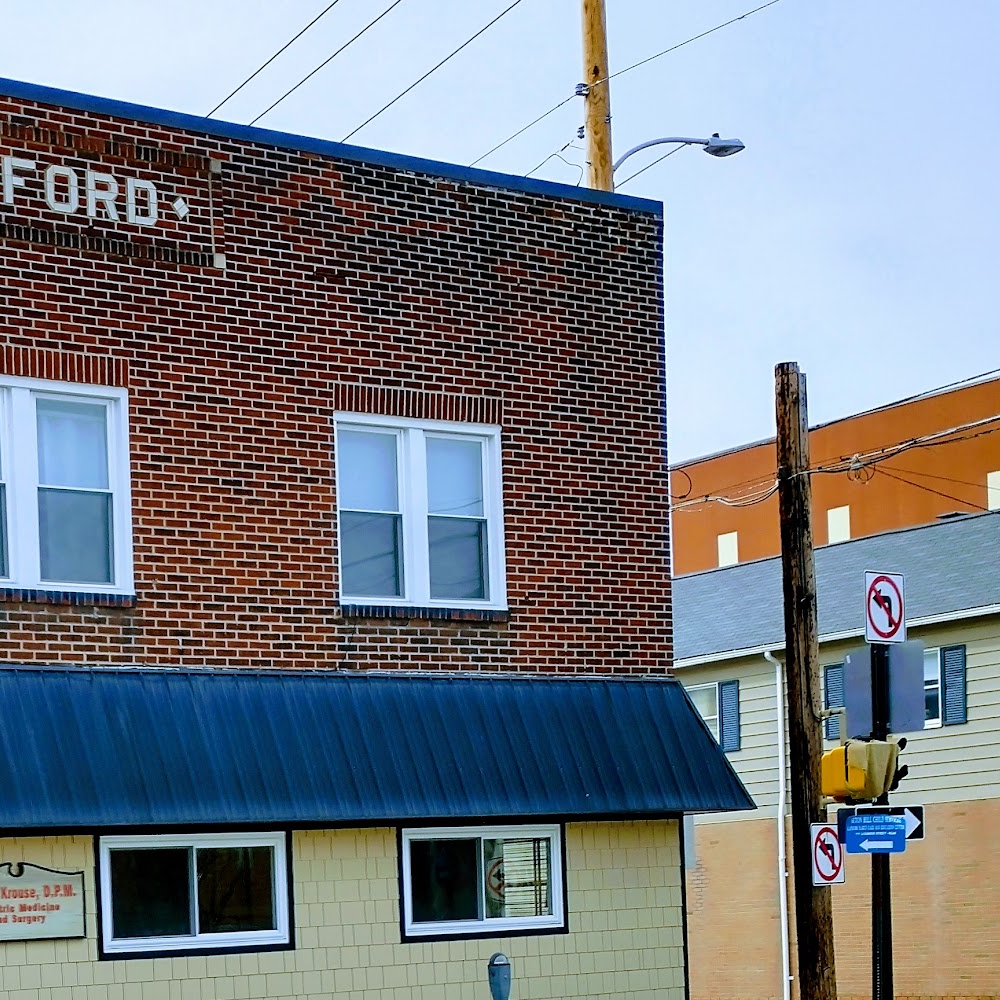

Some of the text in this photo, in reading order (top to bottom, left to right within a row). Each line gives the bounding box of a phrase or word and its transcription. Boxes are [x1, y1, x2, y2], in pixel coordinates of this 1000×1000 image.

[1, 886, 39, 900] Krouse,
[43, 884, 77, 898] D.P.M.
[19, 902, 60, 912] Medicine
[12, 914, 46, 924] Surgery
